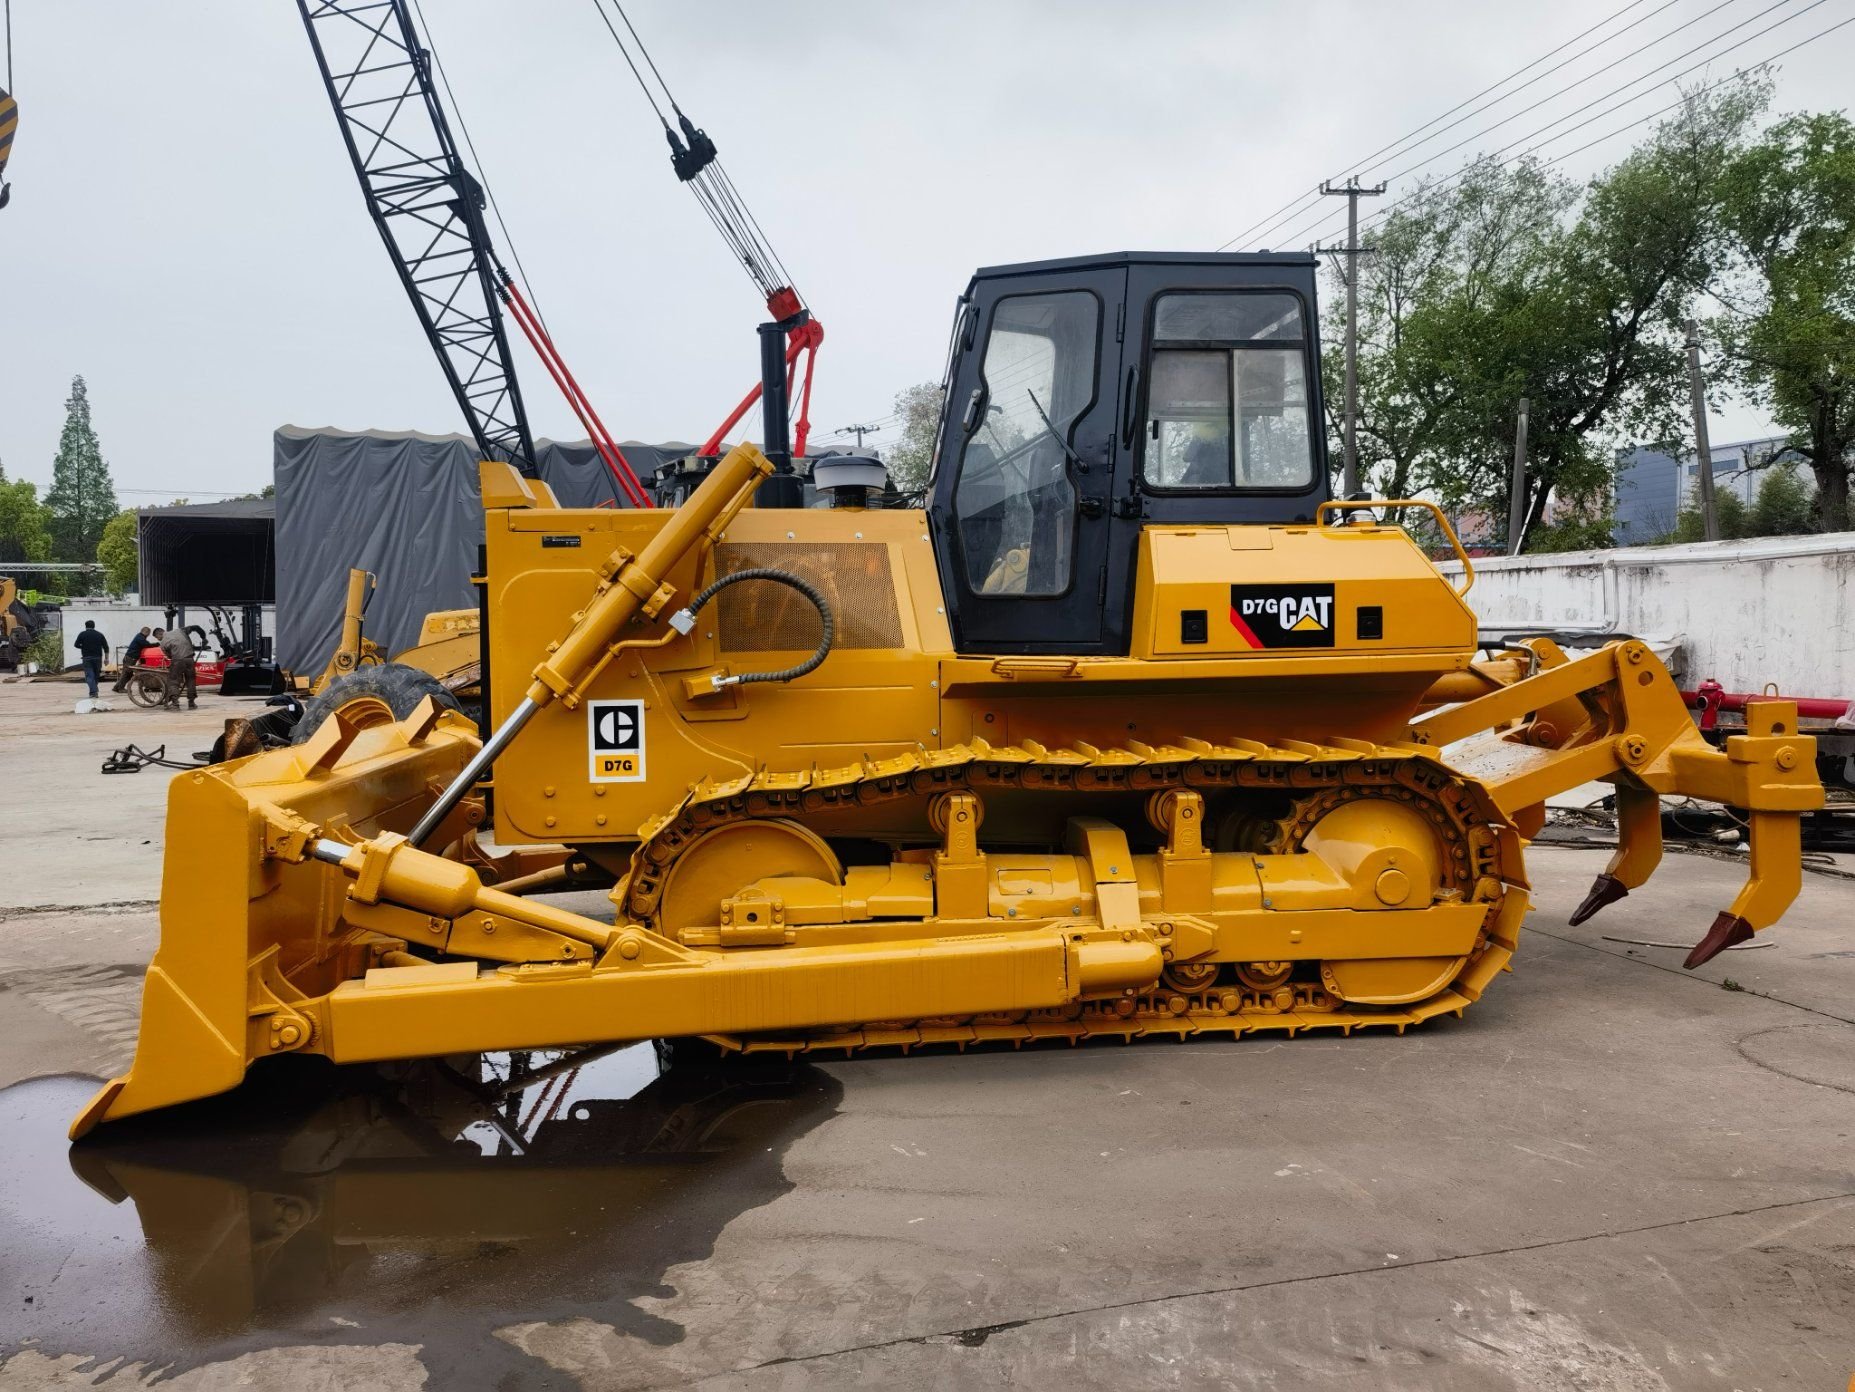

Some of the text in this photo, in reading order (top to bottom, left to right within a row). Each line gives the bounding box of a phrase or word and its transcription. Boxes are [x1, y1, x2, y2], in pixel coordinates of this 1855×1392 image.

[1242, 596, 1333, 630] D7G CAT
[604, 760, 633, 772] D7G
